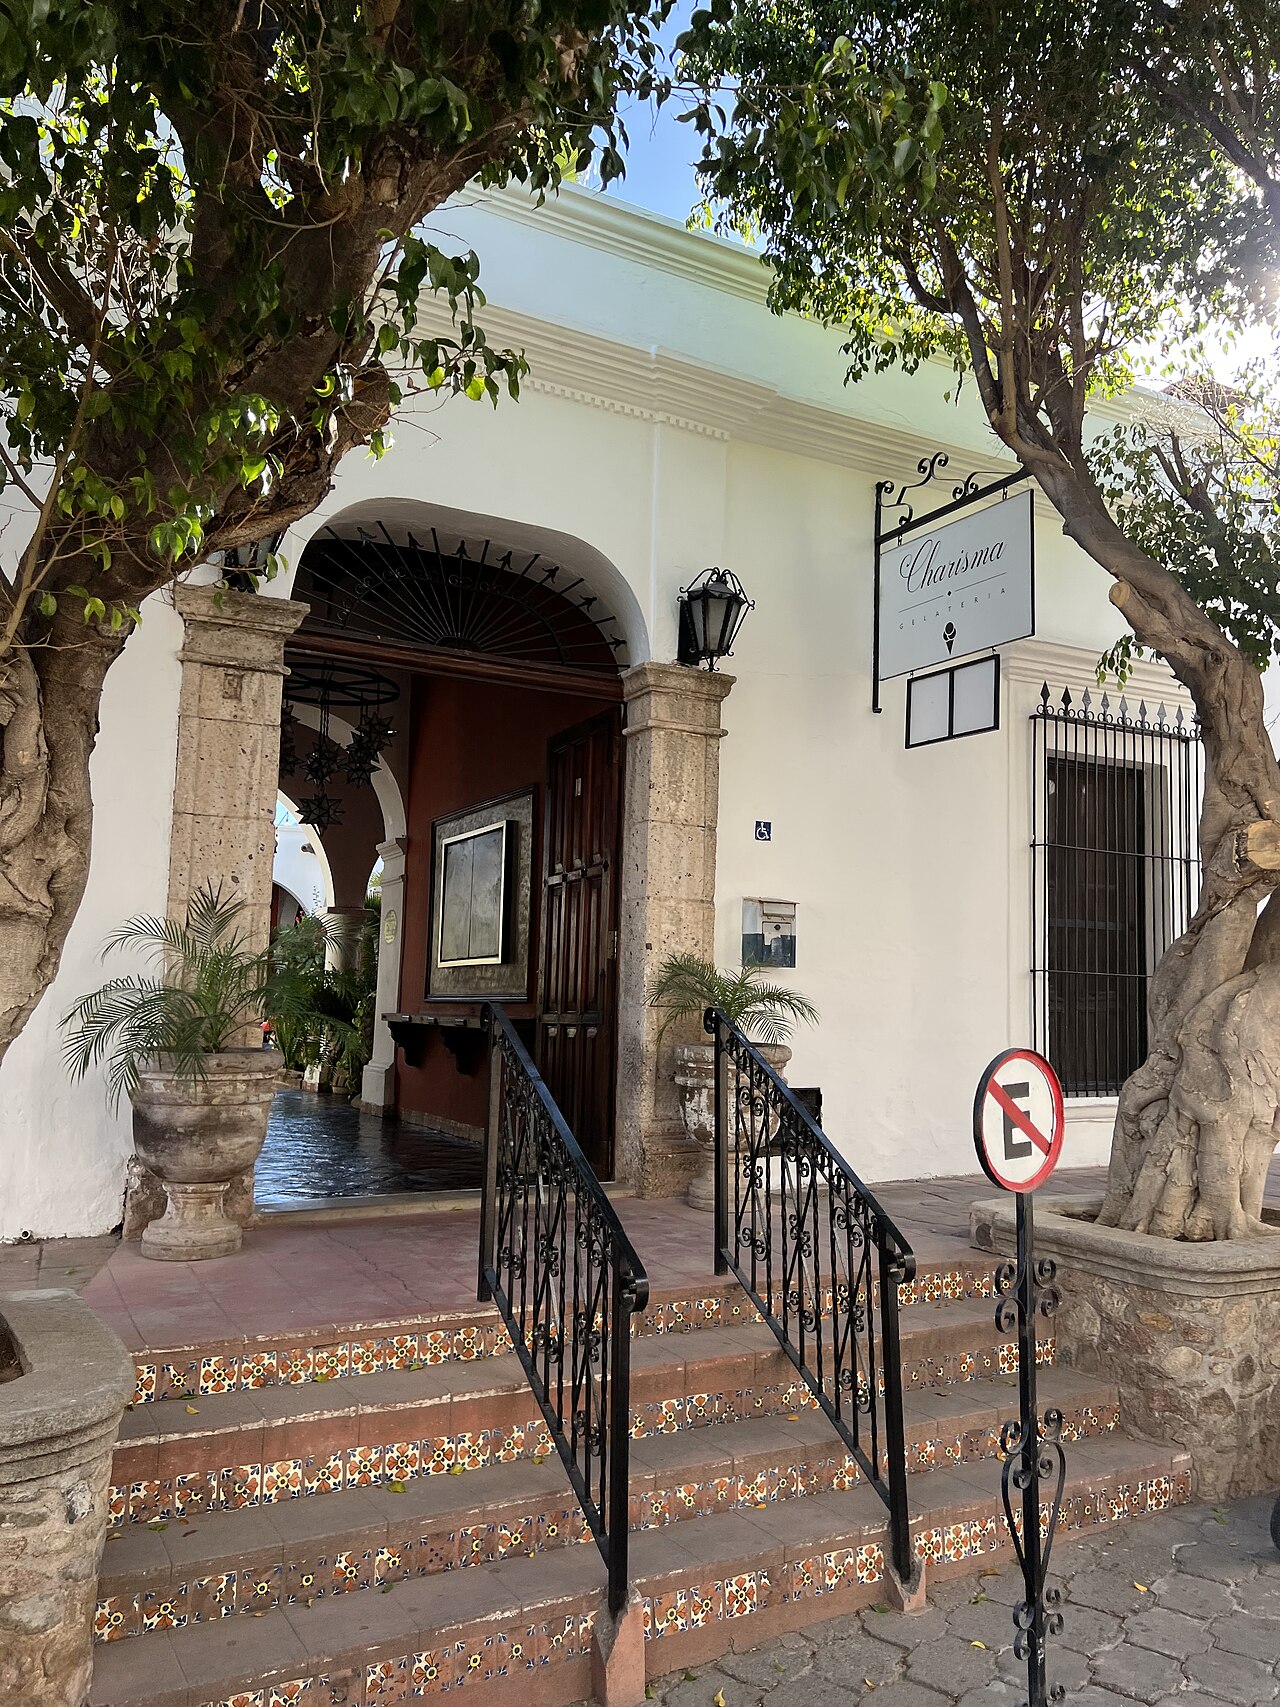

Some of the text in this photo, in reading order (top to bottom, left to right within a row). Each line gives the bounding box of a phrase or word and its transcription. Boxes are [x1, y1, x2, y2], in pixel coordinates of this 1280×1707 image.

[900, 539, 1007, 593] Charisma
[899, 588, 1005, 630] GELATERIA
[1002, 1082, 1032, 1160] E
